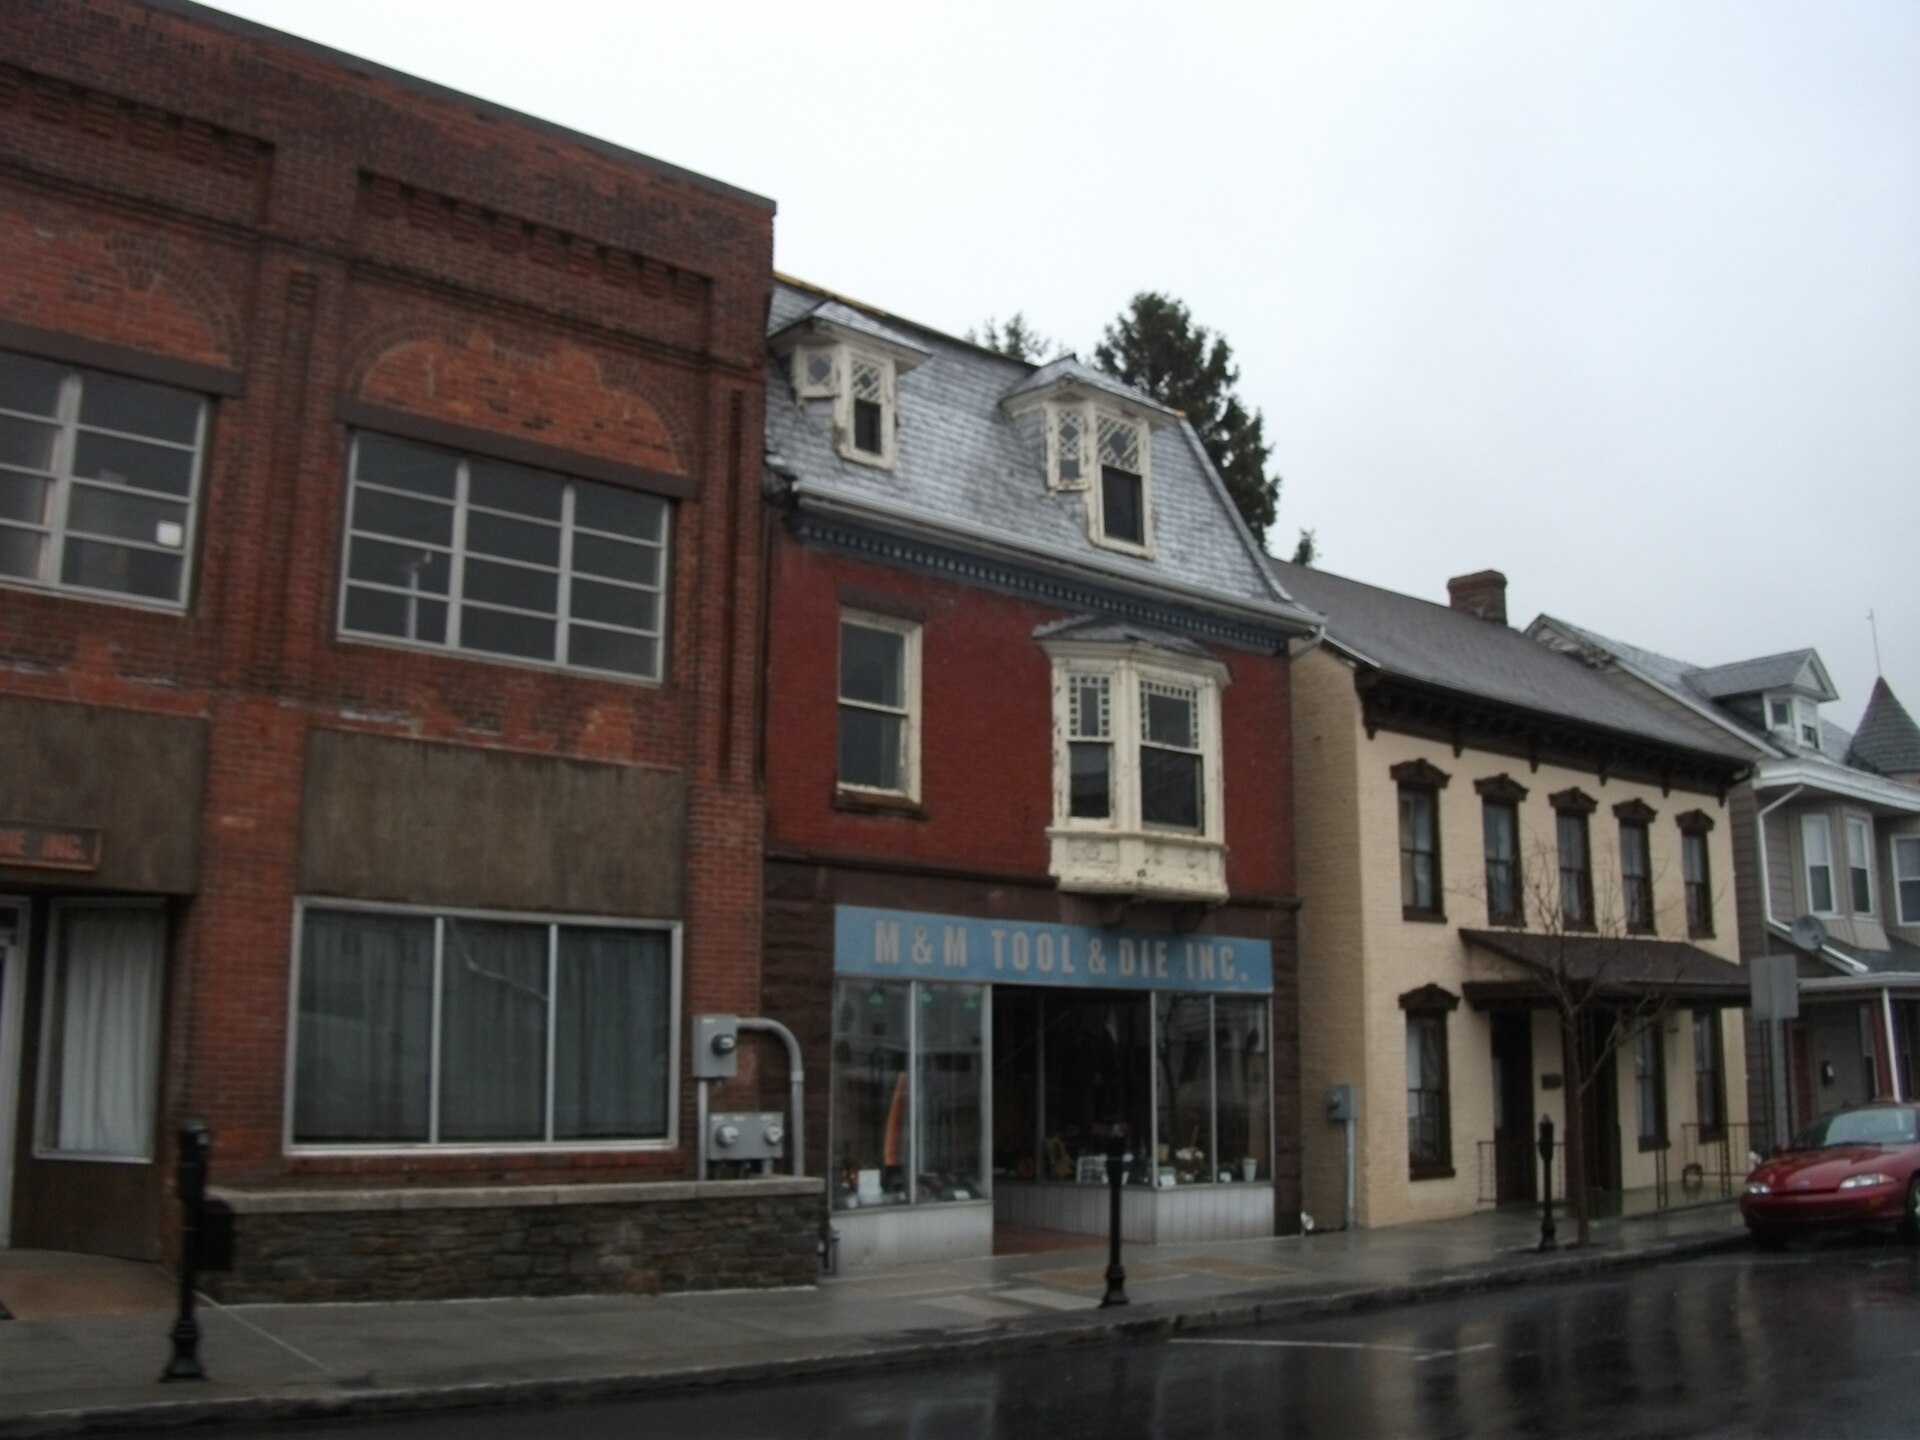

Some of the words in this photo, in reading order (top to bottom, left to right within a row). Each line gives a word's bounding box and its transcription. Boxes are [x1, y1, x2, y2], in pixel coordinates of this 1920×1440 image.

[875, 921, 899, 964] M
[911, 925, 932, 965] &
[944, 925, 966, 966] M
[991, 929, 1076, 974] TOOL
[1088, 938, 1107, 974] &
[1118, 938, 1168, 978] DIE
[1186, 942, 1248, 982] INC.
